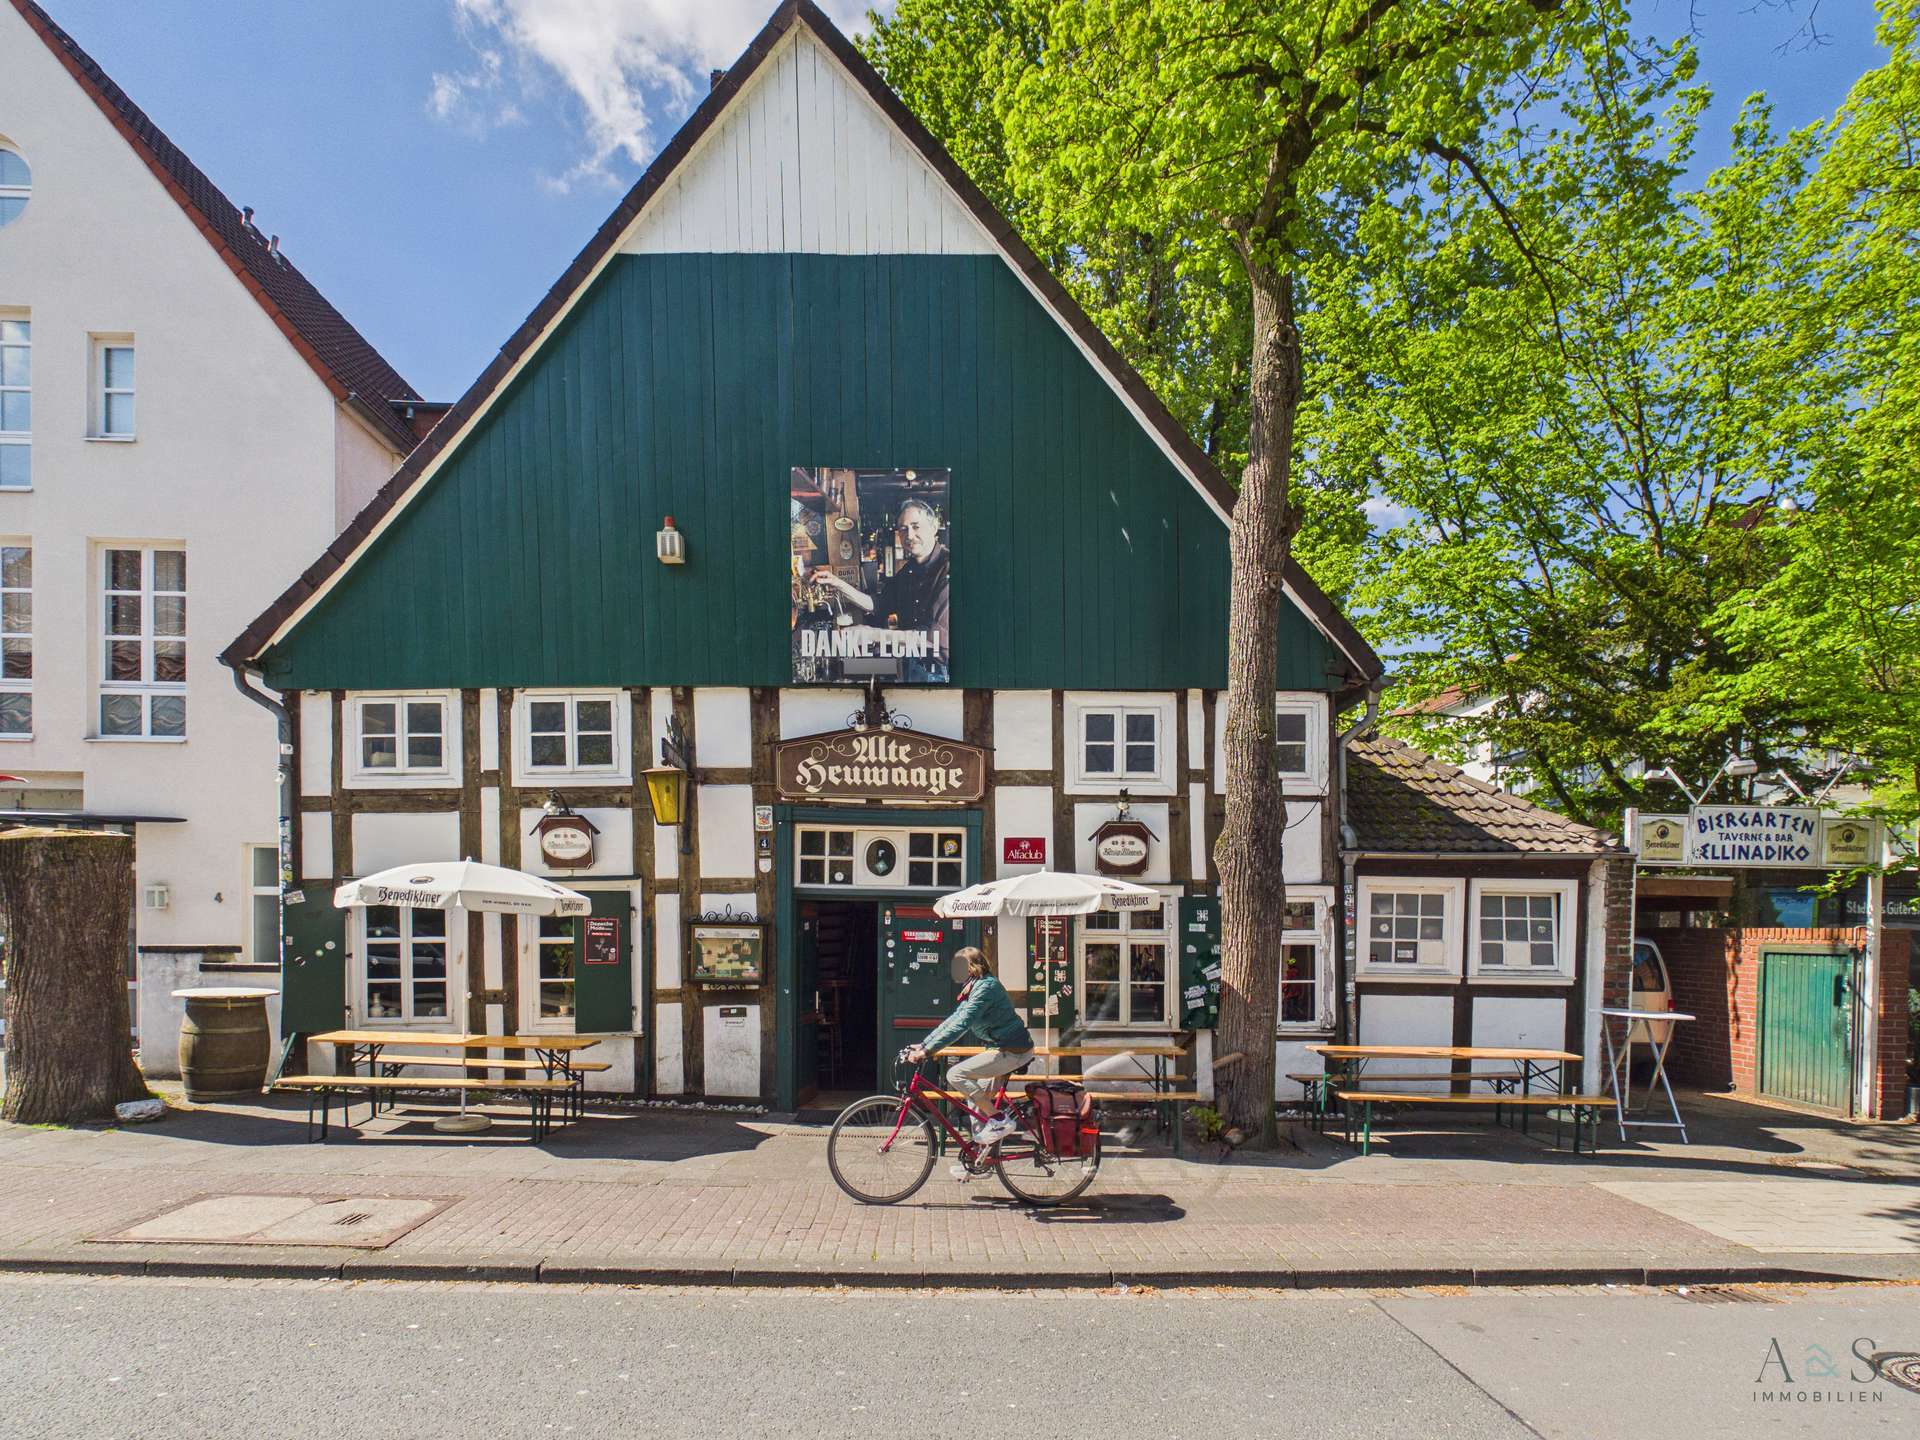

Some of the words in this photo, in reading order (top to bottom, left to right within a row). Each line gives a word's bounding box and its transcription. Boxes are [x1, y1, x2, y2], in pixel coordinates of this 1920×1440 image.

[801, 629, 873, 658] DANKE
[879, 630, 927, 658] ECKI
[852, 735, 913, 764] Alte
[795, 756, 964, 796] Heuwaage
[1697, 811, 1815, 836] BIERGARTEN
[1718, 832, 1764, 842] TAVERNE
[1774, 832, 1793, 842] BAR
[1700, 843, 1809, 861] ELLINADIKO
[378, 886, 441, 904] Benediktiner
[1111, 893, 1149, 909] Benediktiner
[952, 899, 992, 913] Benediktiner
